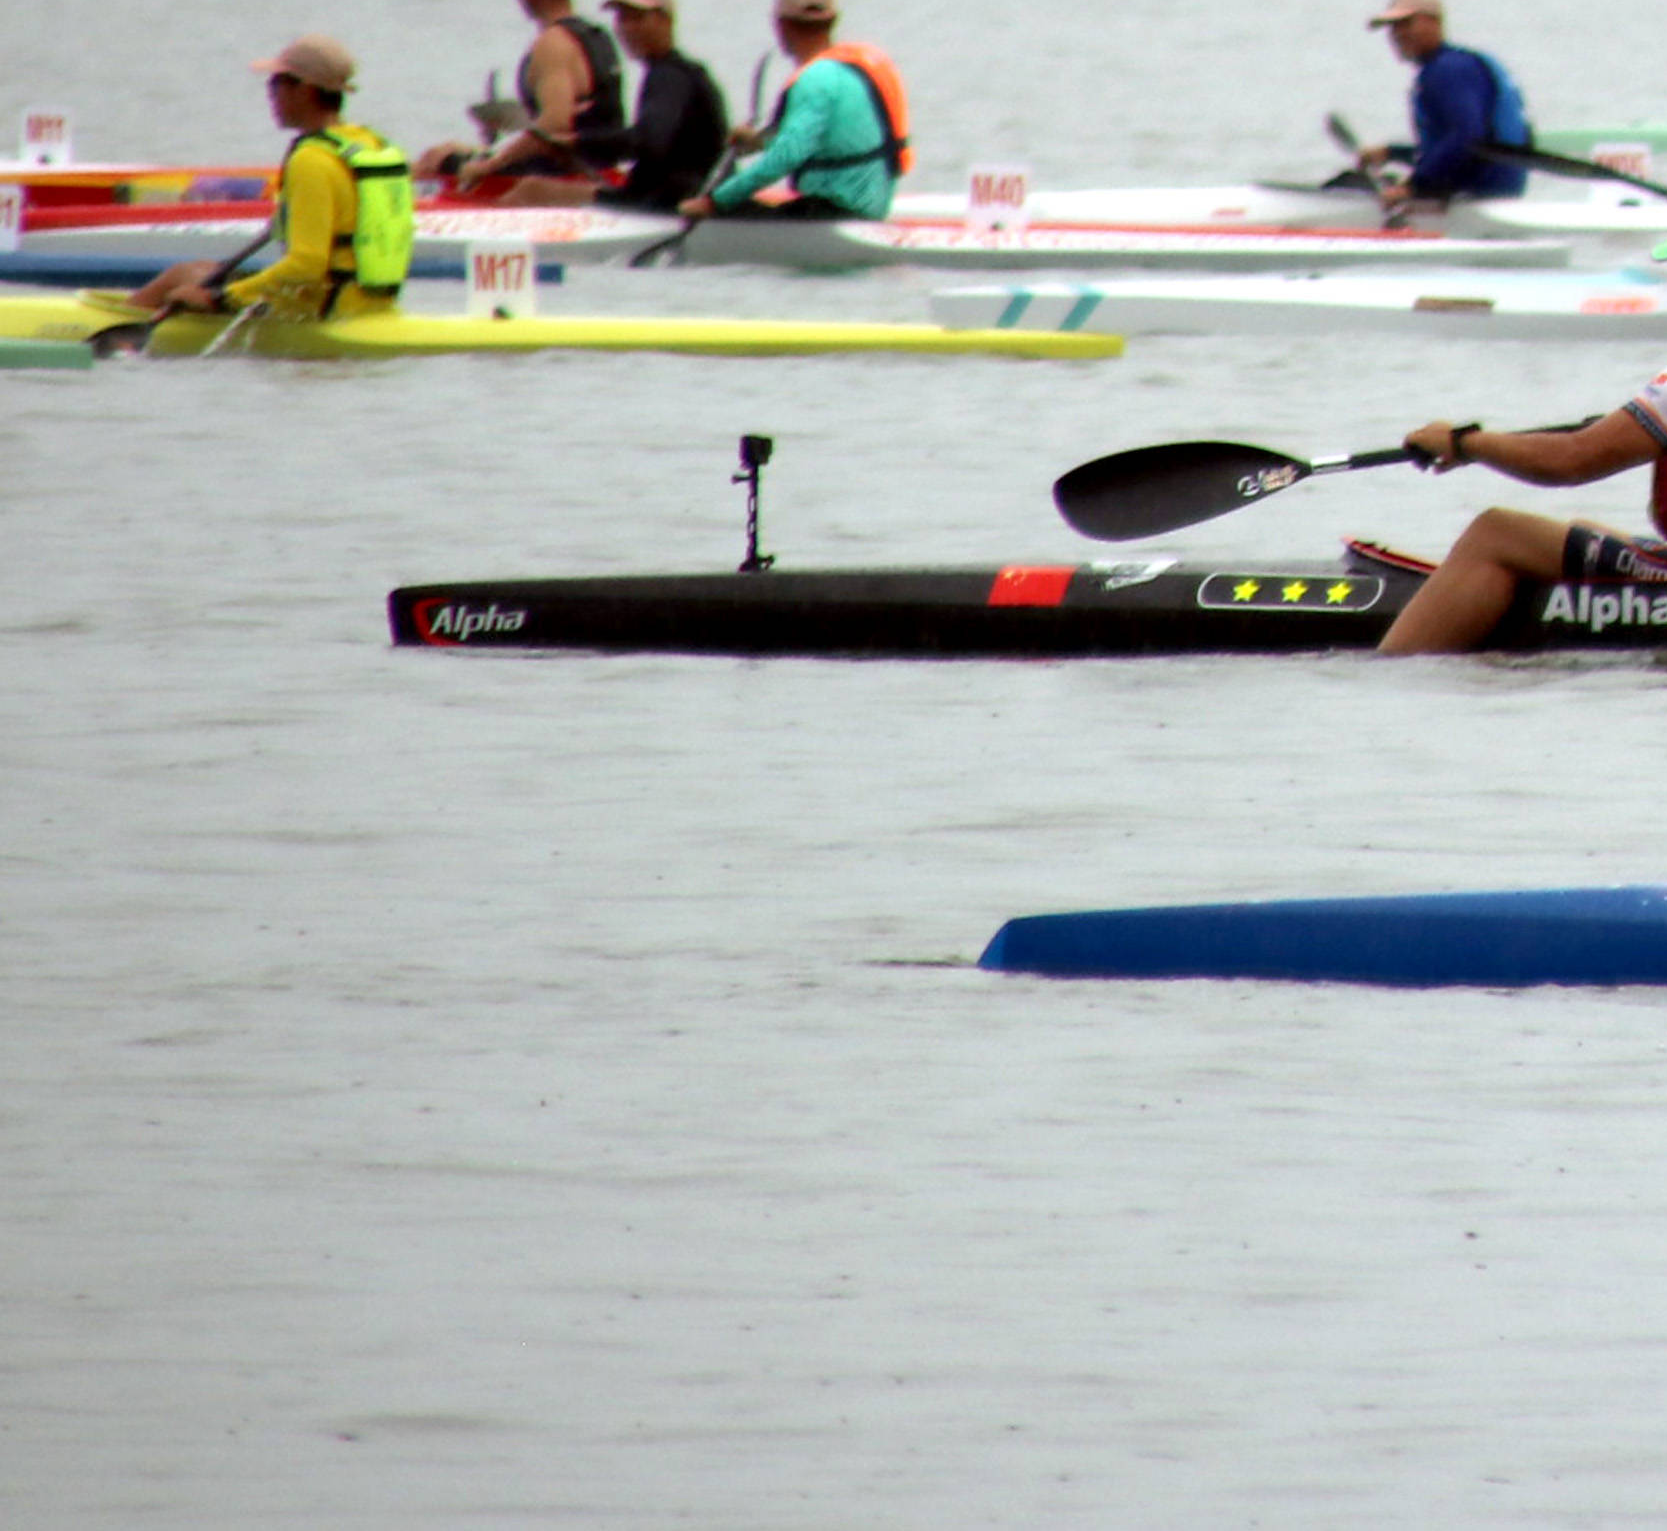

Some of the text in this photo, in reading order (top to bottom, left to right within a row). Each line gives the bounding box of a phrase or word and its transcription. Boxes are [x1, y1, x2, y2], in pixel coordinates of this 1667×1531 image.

[970, 172, 1026, 209] M40
[473, 252, 527, 291] M17
[429, 604, 525, 641] Alpha
